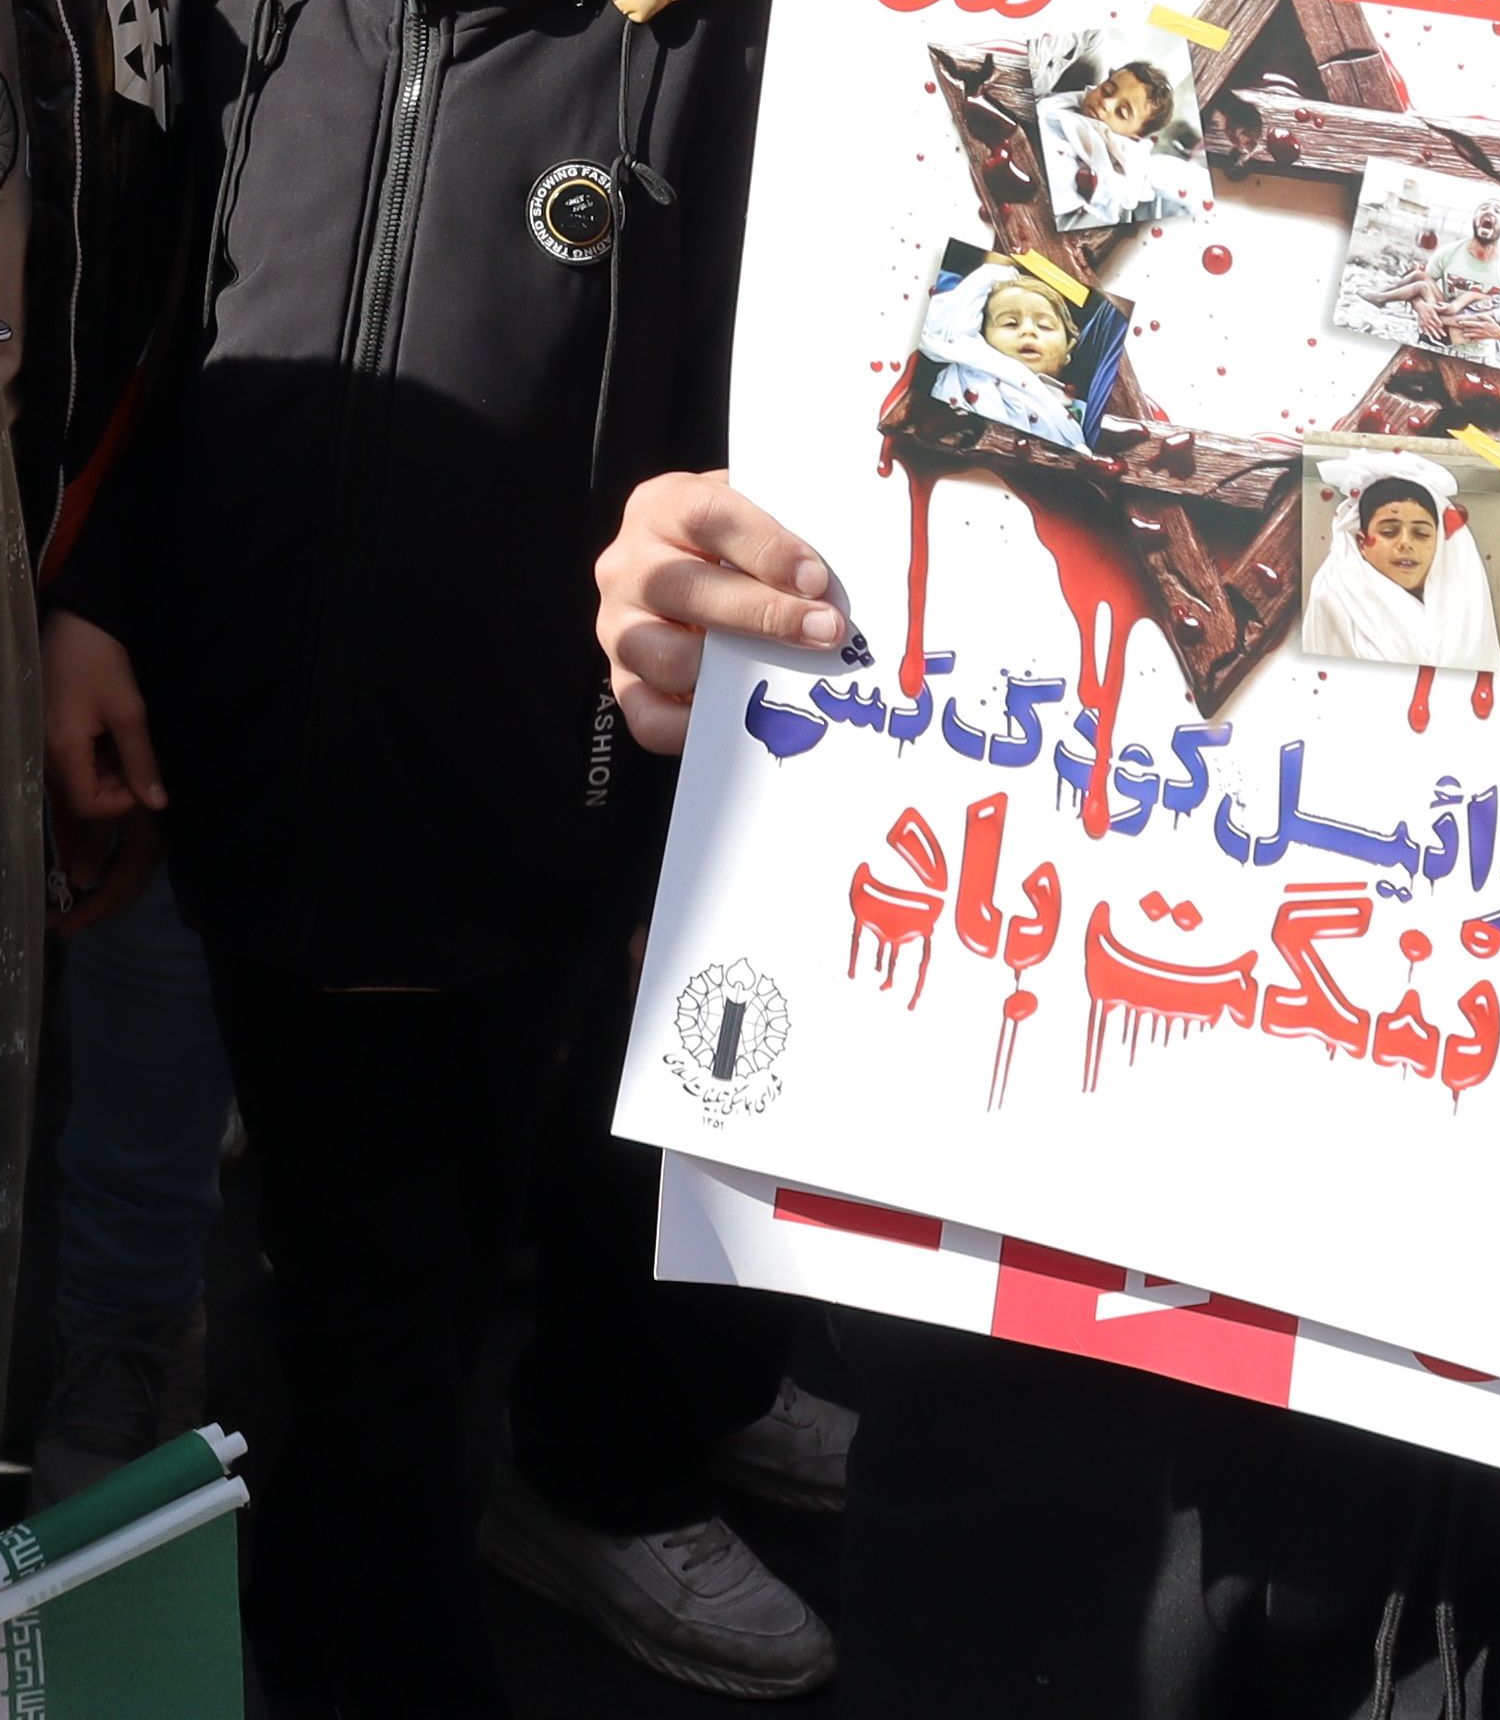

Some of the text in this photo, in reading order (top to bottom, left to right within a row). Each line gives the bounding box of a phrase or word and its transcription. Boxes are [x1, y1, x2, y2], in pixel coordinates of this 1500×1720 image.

[532, 166, 579, 218] SHOWING
[533, 220, 570, 258] TREND
[848, 791, 1062, 1022] باد
